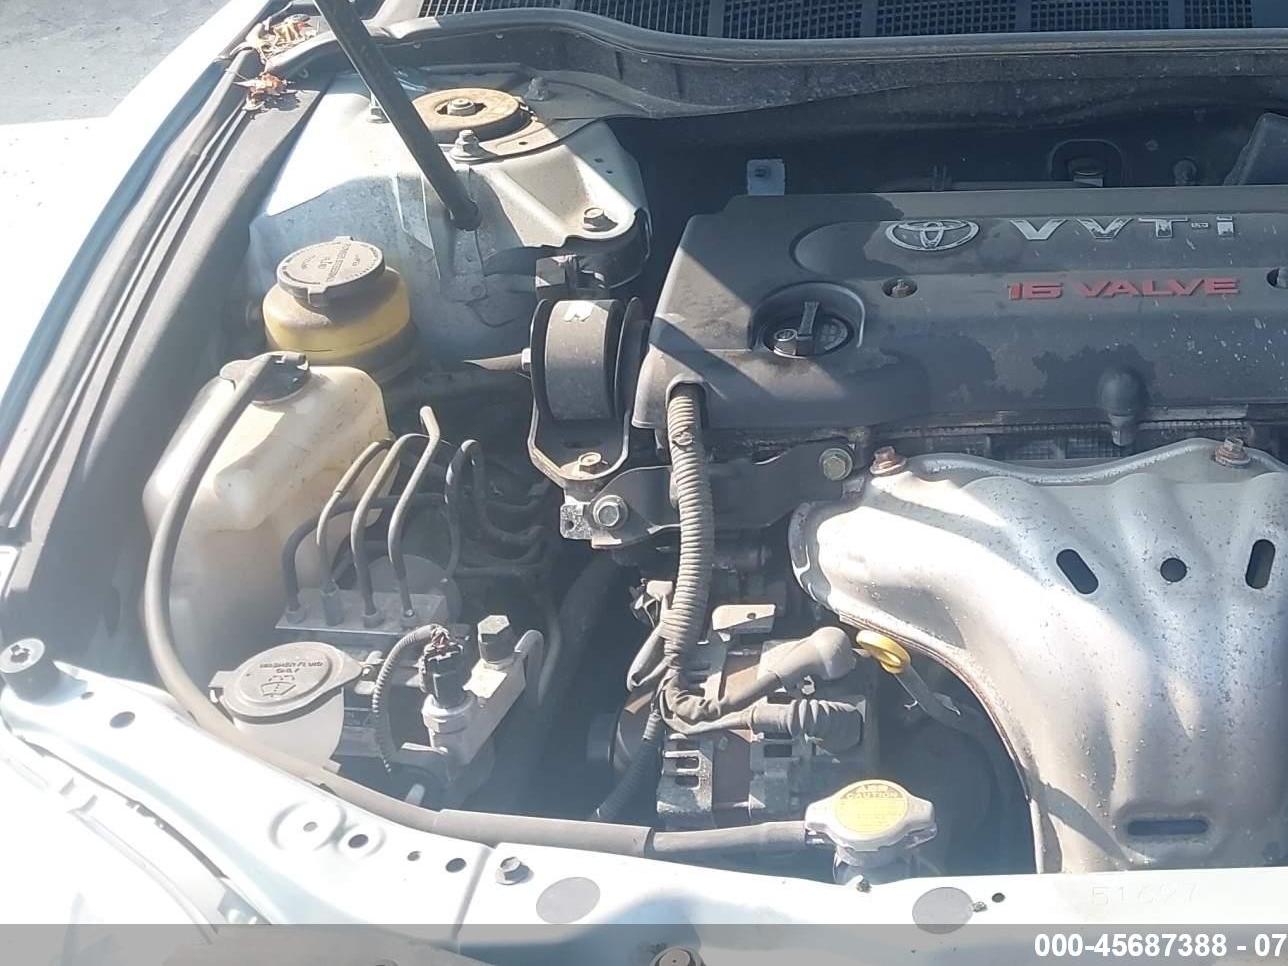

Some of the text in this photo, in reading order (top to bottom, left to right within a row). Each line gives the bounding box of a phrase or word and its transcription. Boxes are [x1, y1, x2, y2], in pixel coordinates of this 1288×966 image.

[1010, 216, 1235, 241] VVT-i
[1006, 278, 1242, 300] 16 VALVE
